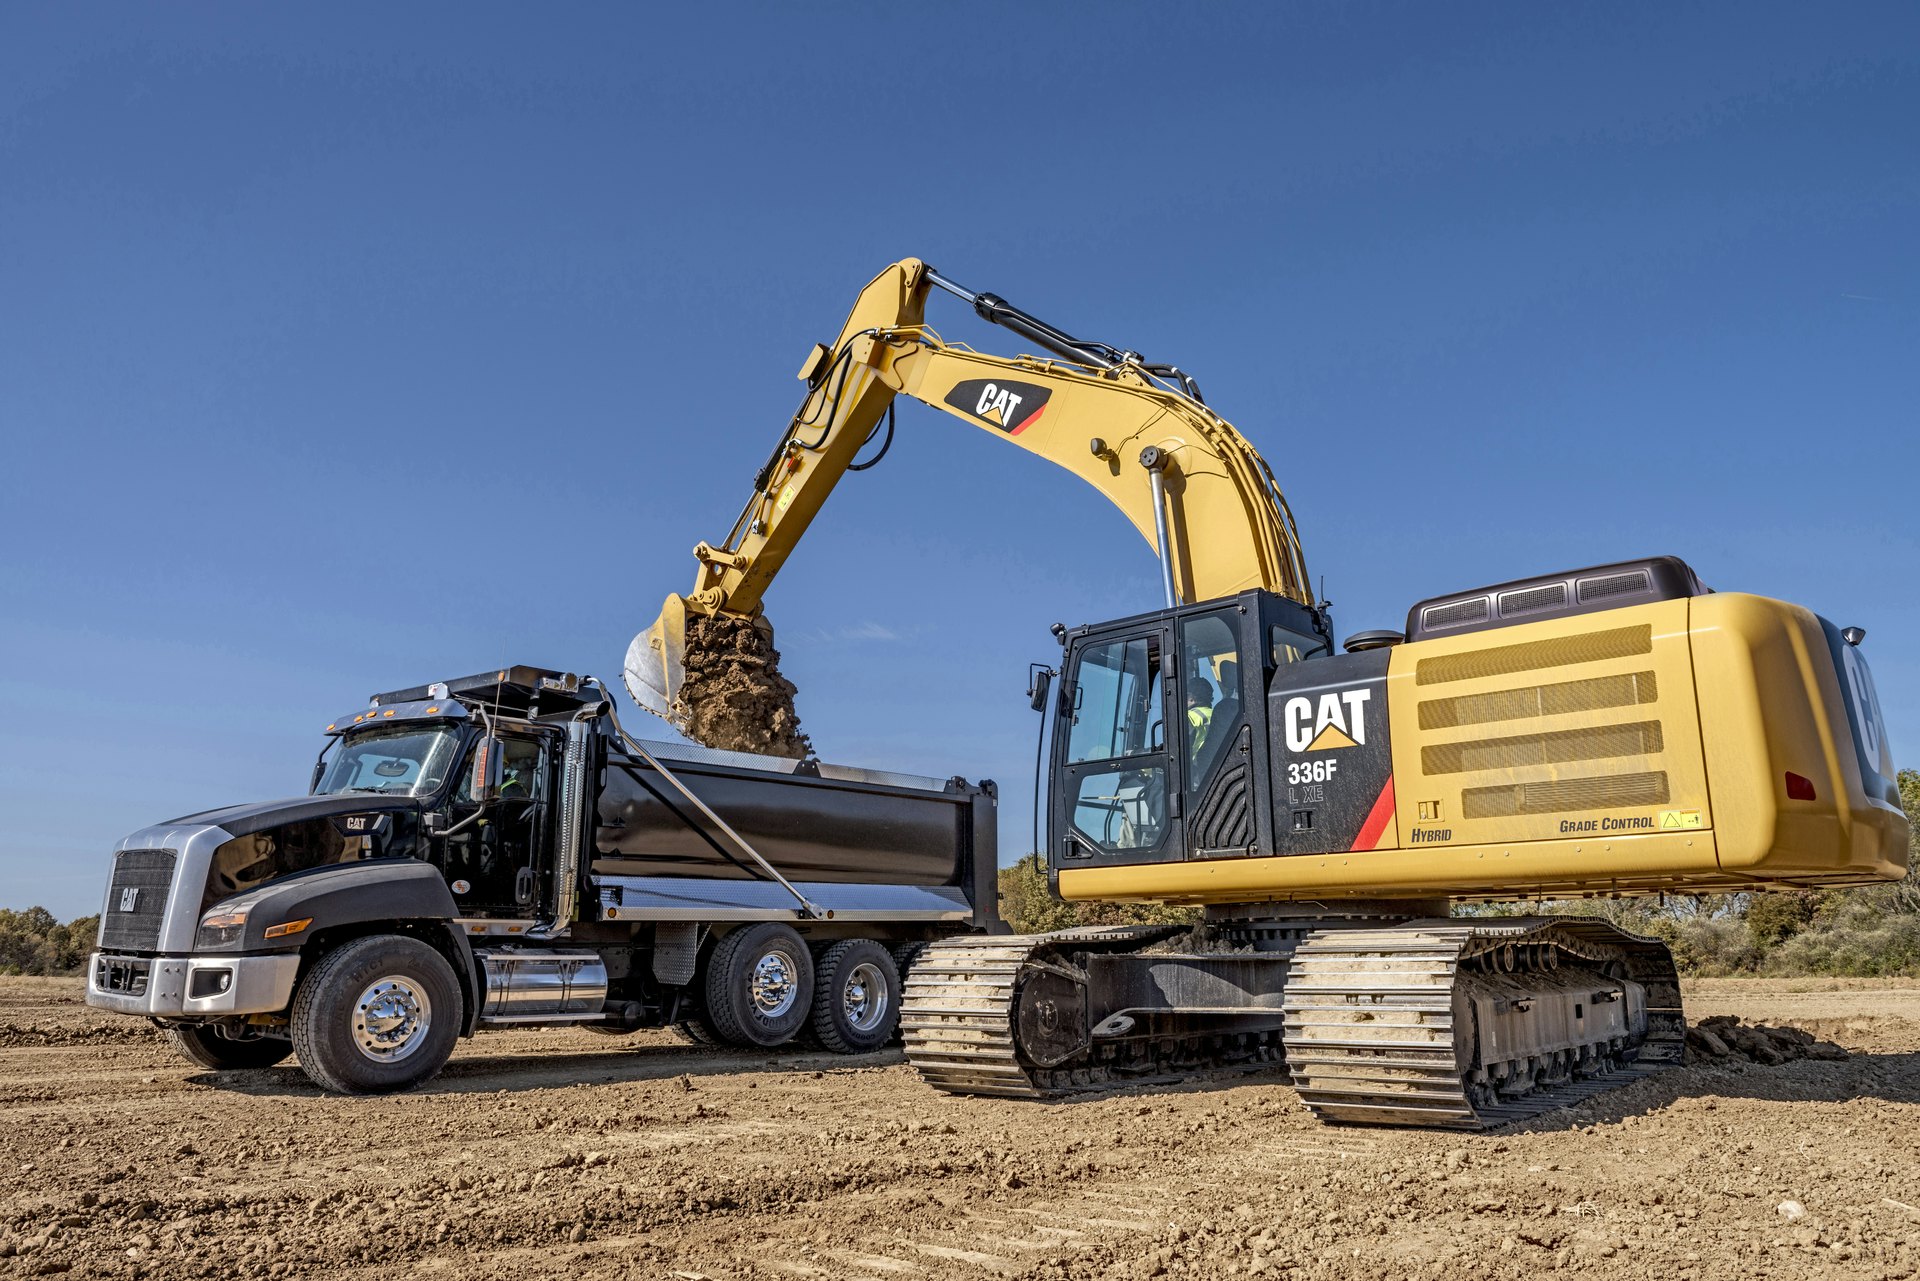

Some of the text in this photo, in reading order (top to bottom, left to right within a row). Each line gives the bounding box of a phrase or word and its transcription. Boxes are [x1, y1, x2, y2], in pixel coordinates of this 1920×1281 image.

[975, 382, 1023, 427] CAT
[1284, 688, 1371, 753] CAT
[1288, 759, 1337, 785] 336F
[1288, 785, 1324, 805] L XE
[346, 817, 367, 830] CAT
[119, 887, 139, 912] CAT
